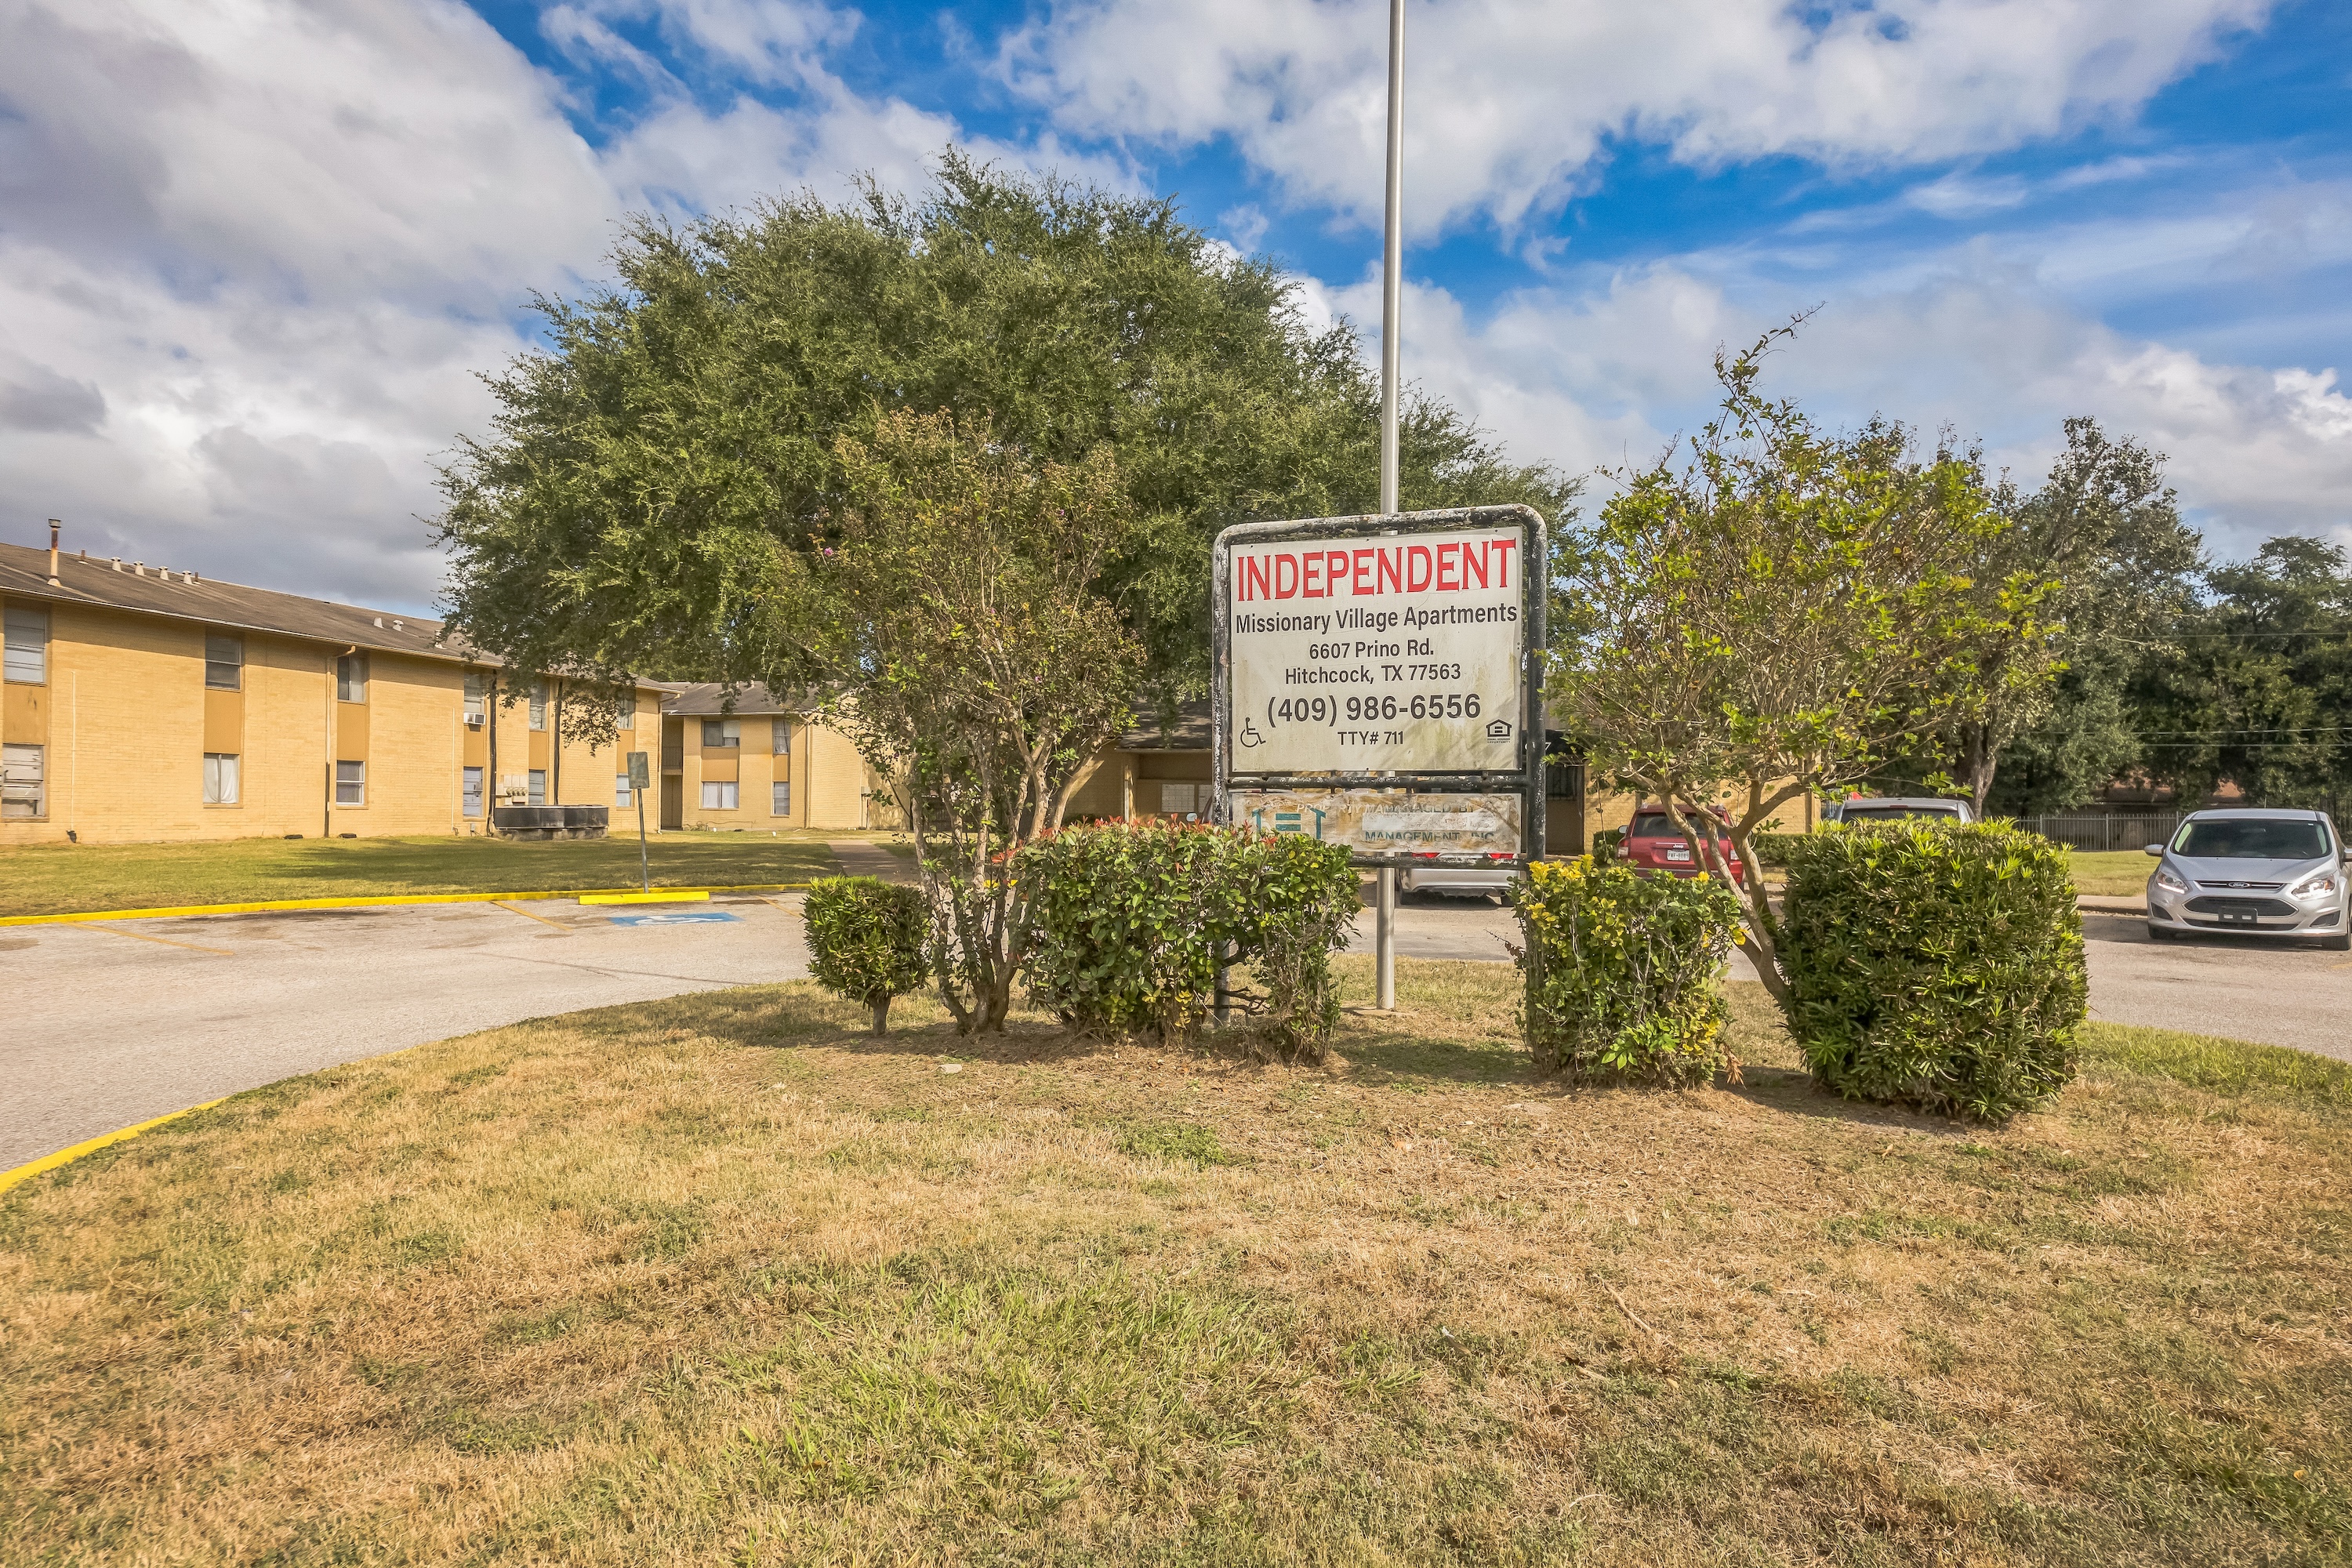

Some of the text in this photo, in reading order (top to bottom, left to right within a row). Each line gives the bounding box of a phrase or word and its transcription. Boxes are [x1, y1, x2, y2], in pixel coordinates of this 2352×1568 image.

[1237, 538, 1516, 601] INDEPENDENT
[1236, 603, 1518, 634] Missionary Village Apartments
[1309, 638, 1434, 659] 6607 Prino Rd.
[1285, 663, 1461, 684] Hitchcock, TX 77563
[1268, 693, 1481, 728] (409) 986-6556
[1338, 731, 1403, 746] TTY# 711
[1297, 804, 1362, 814] PROPRTY
[1364, 831, 1461, 843] MANAGEMENT
